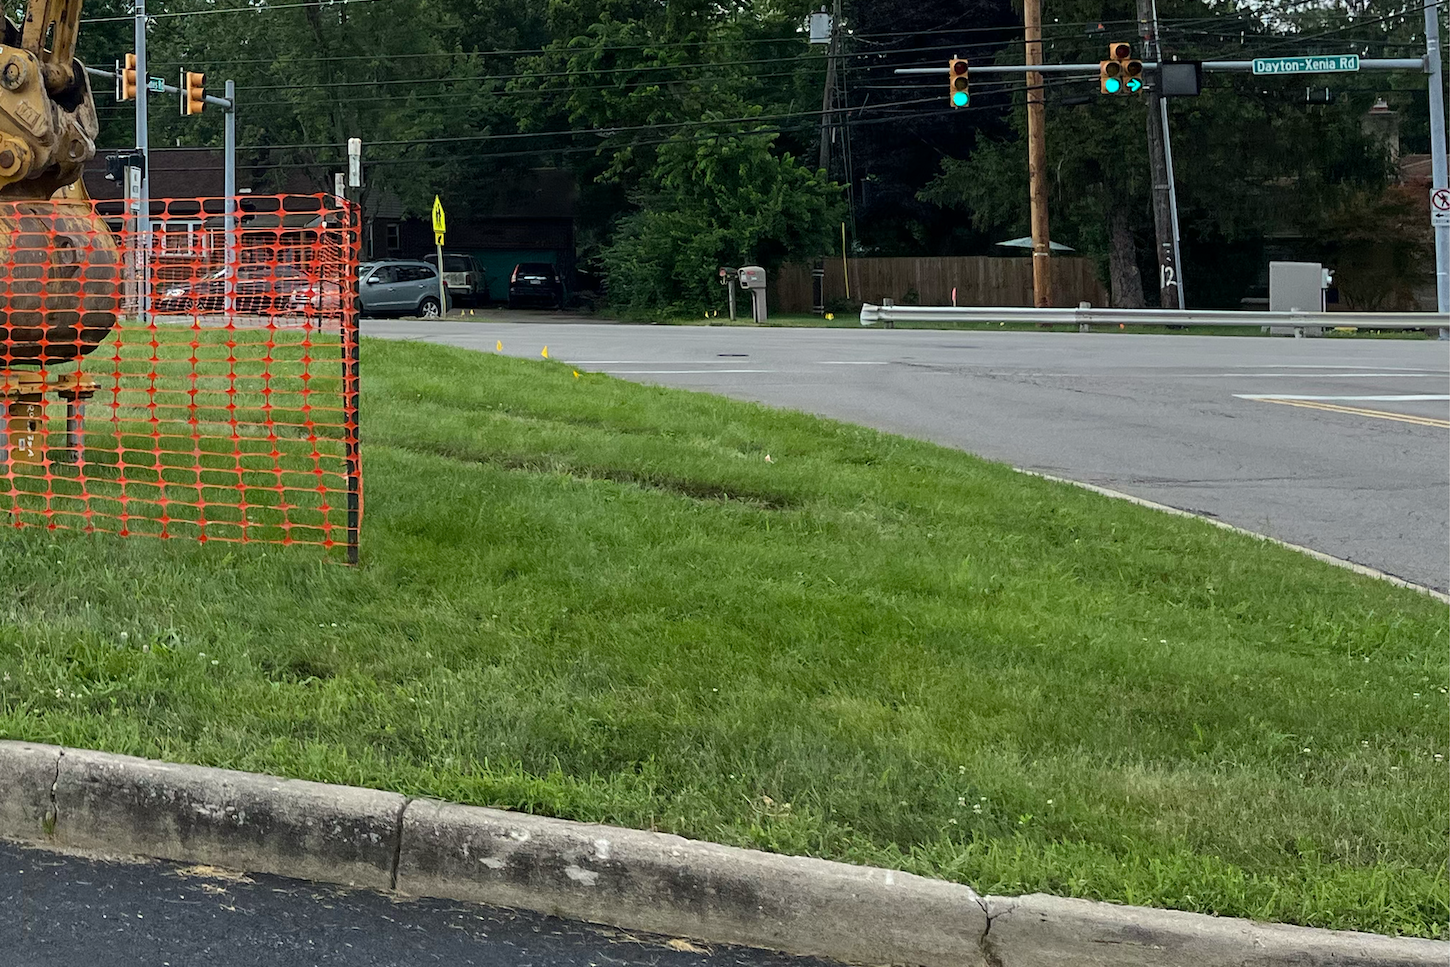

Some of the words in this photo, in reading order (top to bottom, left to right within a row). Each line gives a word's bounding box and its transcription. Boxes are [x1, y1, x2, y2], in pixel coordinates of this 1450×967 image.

[1257, 58, 1335, 73] Dayton-Xenia
[1339, 57, 1355, 69] Rd
[1160, 264, 1177, 289] 12
